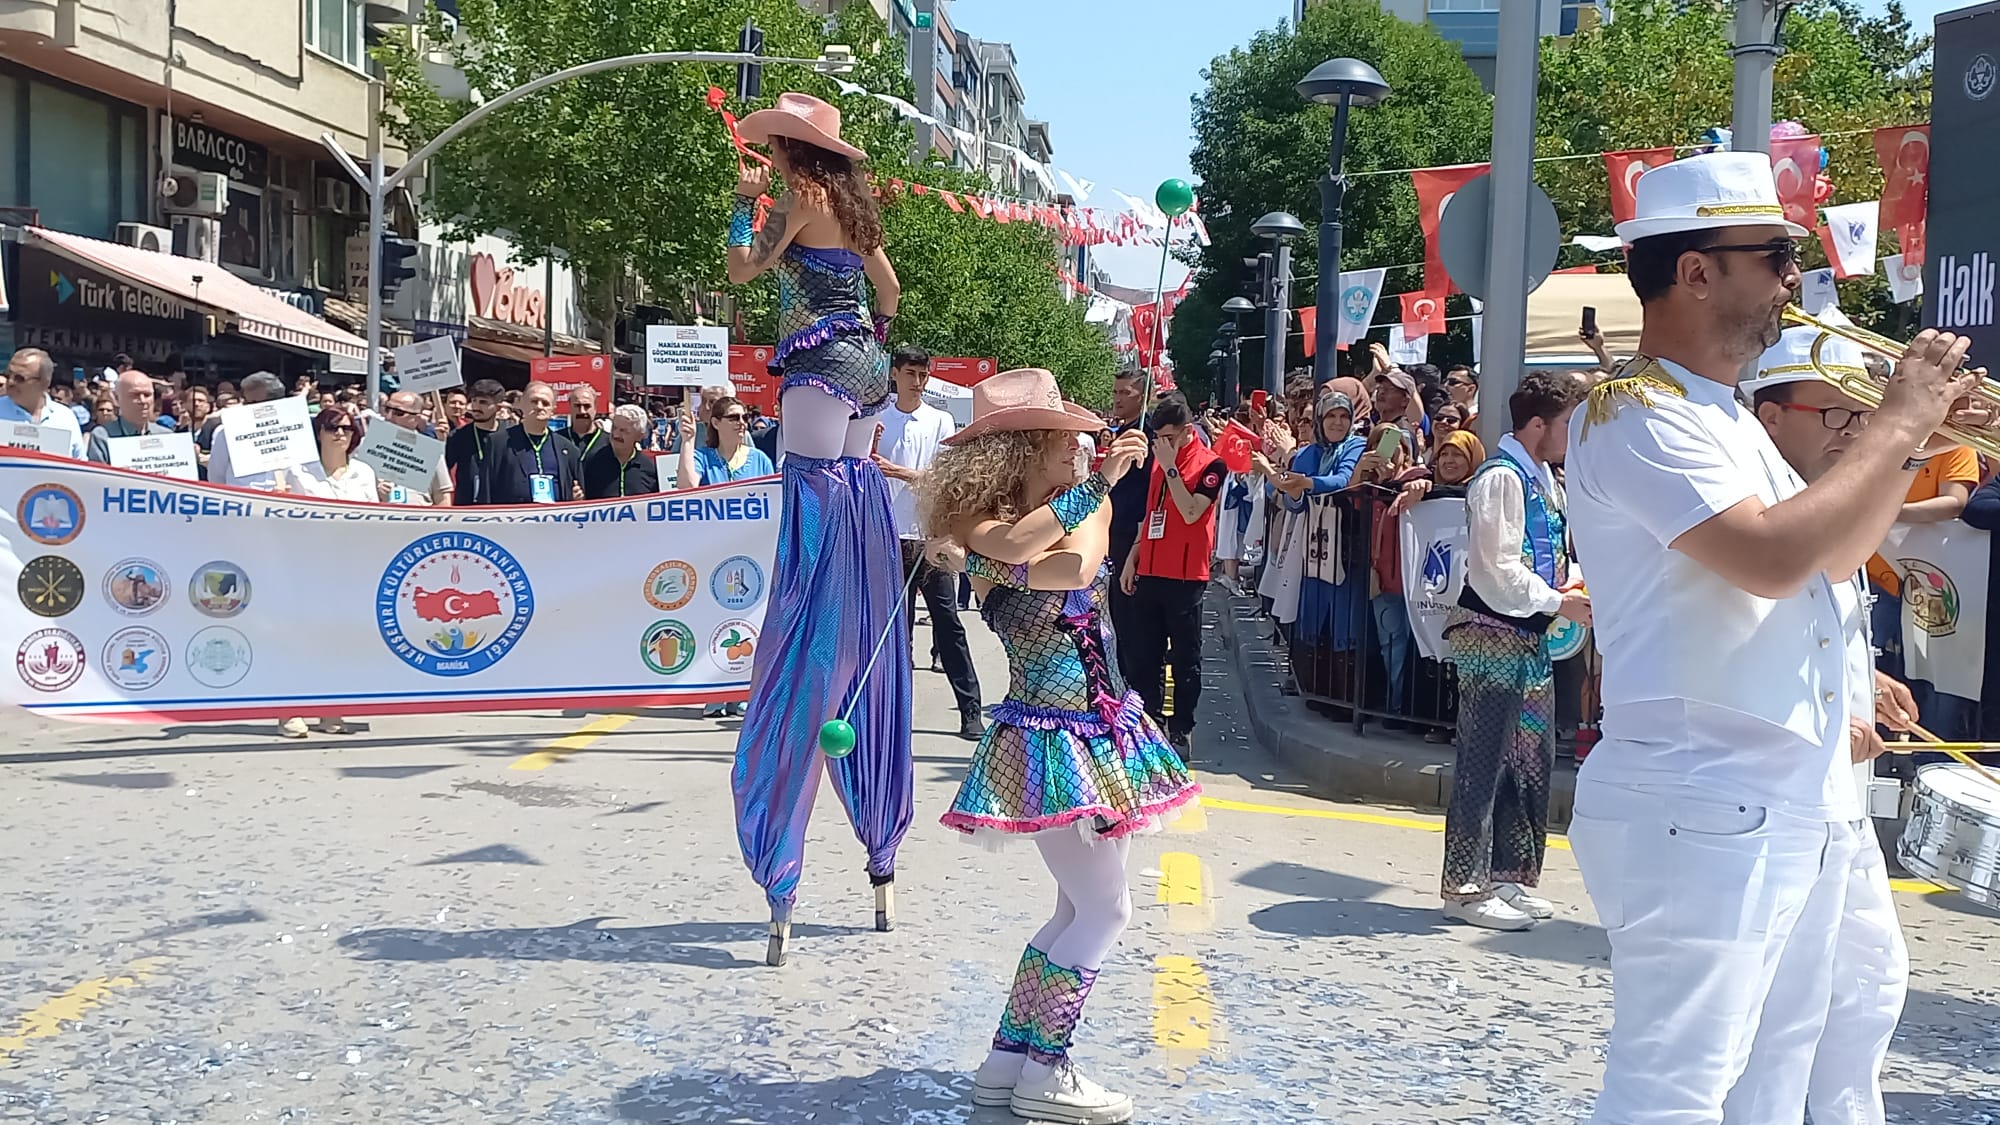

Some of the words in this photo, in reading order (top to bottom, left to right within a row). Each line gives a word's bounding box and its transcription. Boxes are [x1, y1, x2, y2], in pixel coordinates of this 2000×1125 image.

[178, 122, 246, 166] BARACCO
[77, 278, 115, 311] Türk
[119, 285, 185, 320] Telekom
[1936, 252, 1996, 327] Halk
[682, 342, 717, 350] MAKEDONYA
[103, 487, 252, 523] HEMŞERİ
[648, 492, 770, 522] DERNEĞİ
[383, 535, 458, 598] KÜLTÜRLERİ
[463, 537, 528, 602] DAYANIŞMA
[380, 600, 426, 665] HEMŞEHRİ
[485, 605, 529, 662] DERNEĞİ
